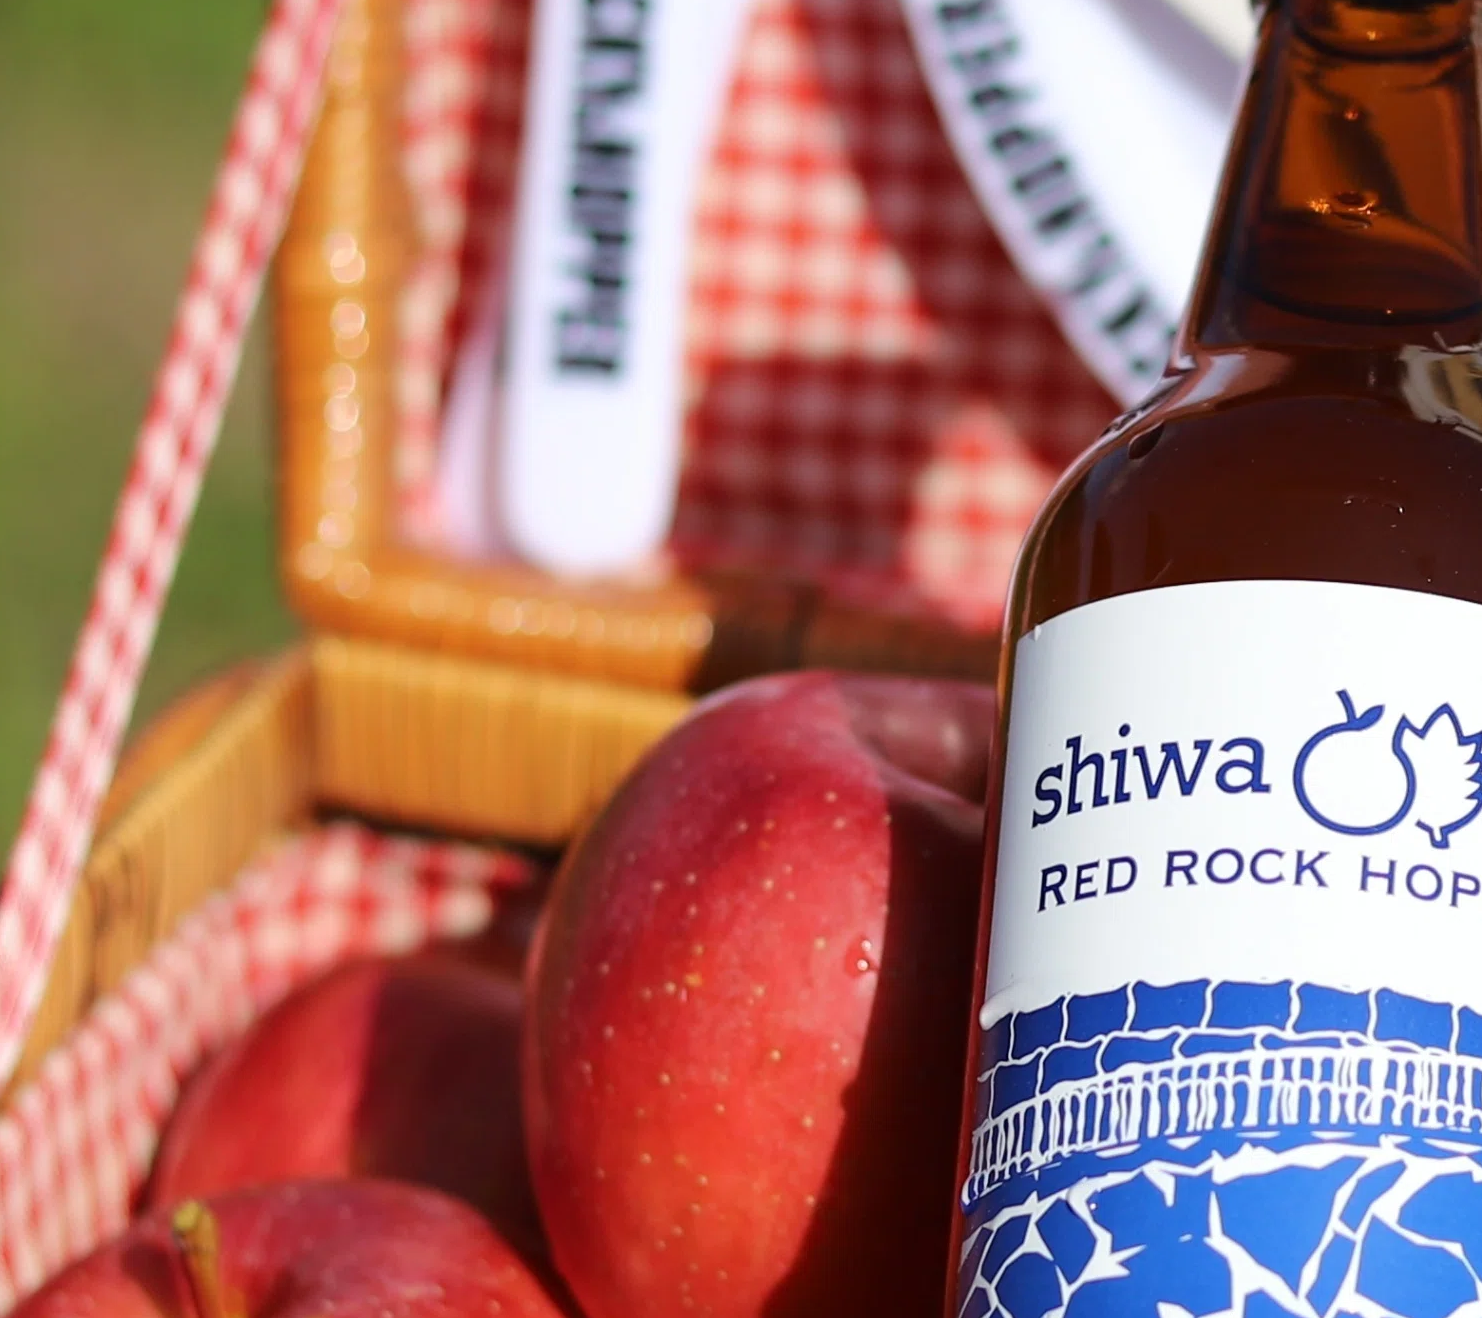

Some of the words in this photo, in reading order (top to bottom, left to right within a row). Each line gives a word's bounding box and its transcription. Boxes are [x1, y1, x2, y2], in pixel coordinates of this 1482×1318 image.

[1032, 723, 1272, 828] shiwa
[1037, 855, 1138, 913] RED
[1164, 847, 1331, 887] ROCK
